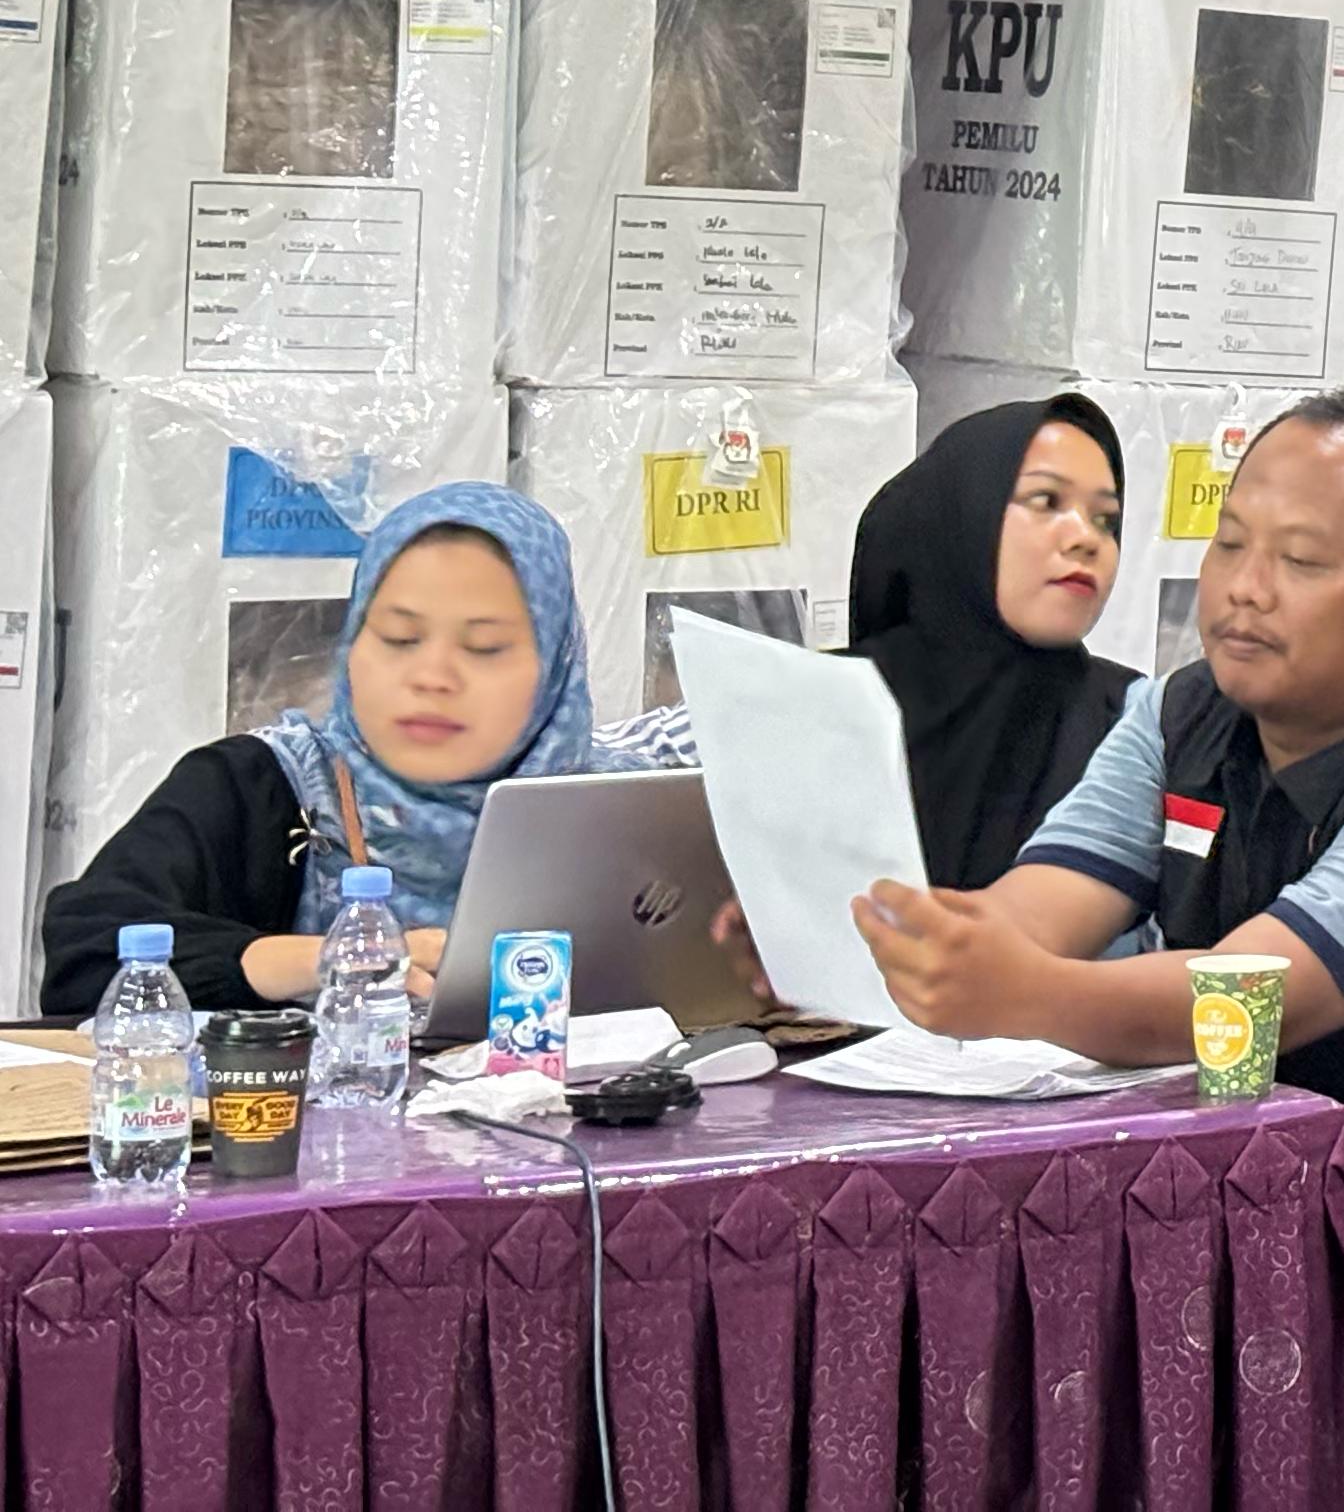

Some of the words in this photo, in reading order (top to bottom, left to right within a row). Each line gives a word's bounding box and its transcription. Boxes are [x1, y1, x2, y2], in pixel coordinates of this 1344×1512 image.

[942, 0, 1063, 98] KPU
[952, 120, 1039, 154] PEMILU
[922, 162, 999, 197] TAHUN
[1005, 168, 1061, 201] 2024
[676, 491, 731, 517] DPR
[735, 488, 761, 514] RI
[208, 1070, 267, 1085] COFFEE
[272, 1069, 306, 1083] WAY
[121, 1105, 187, 1128] Minerale
[154, 1095, 174, 1112] Le
